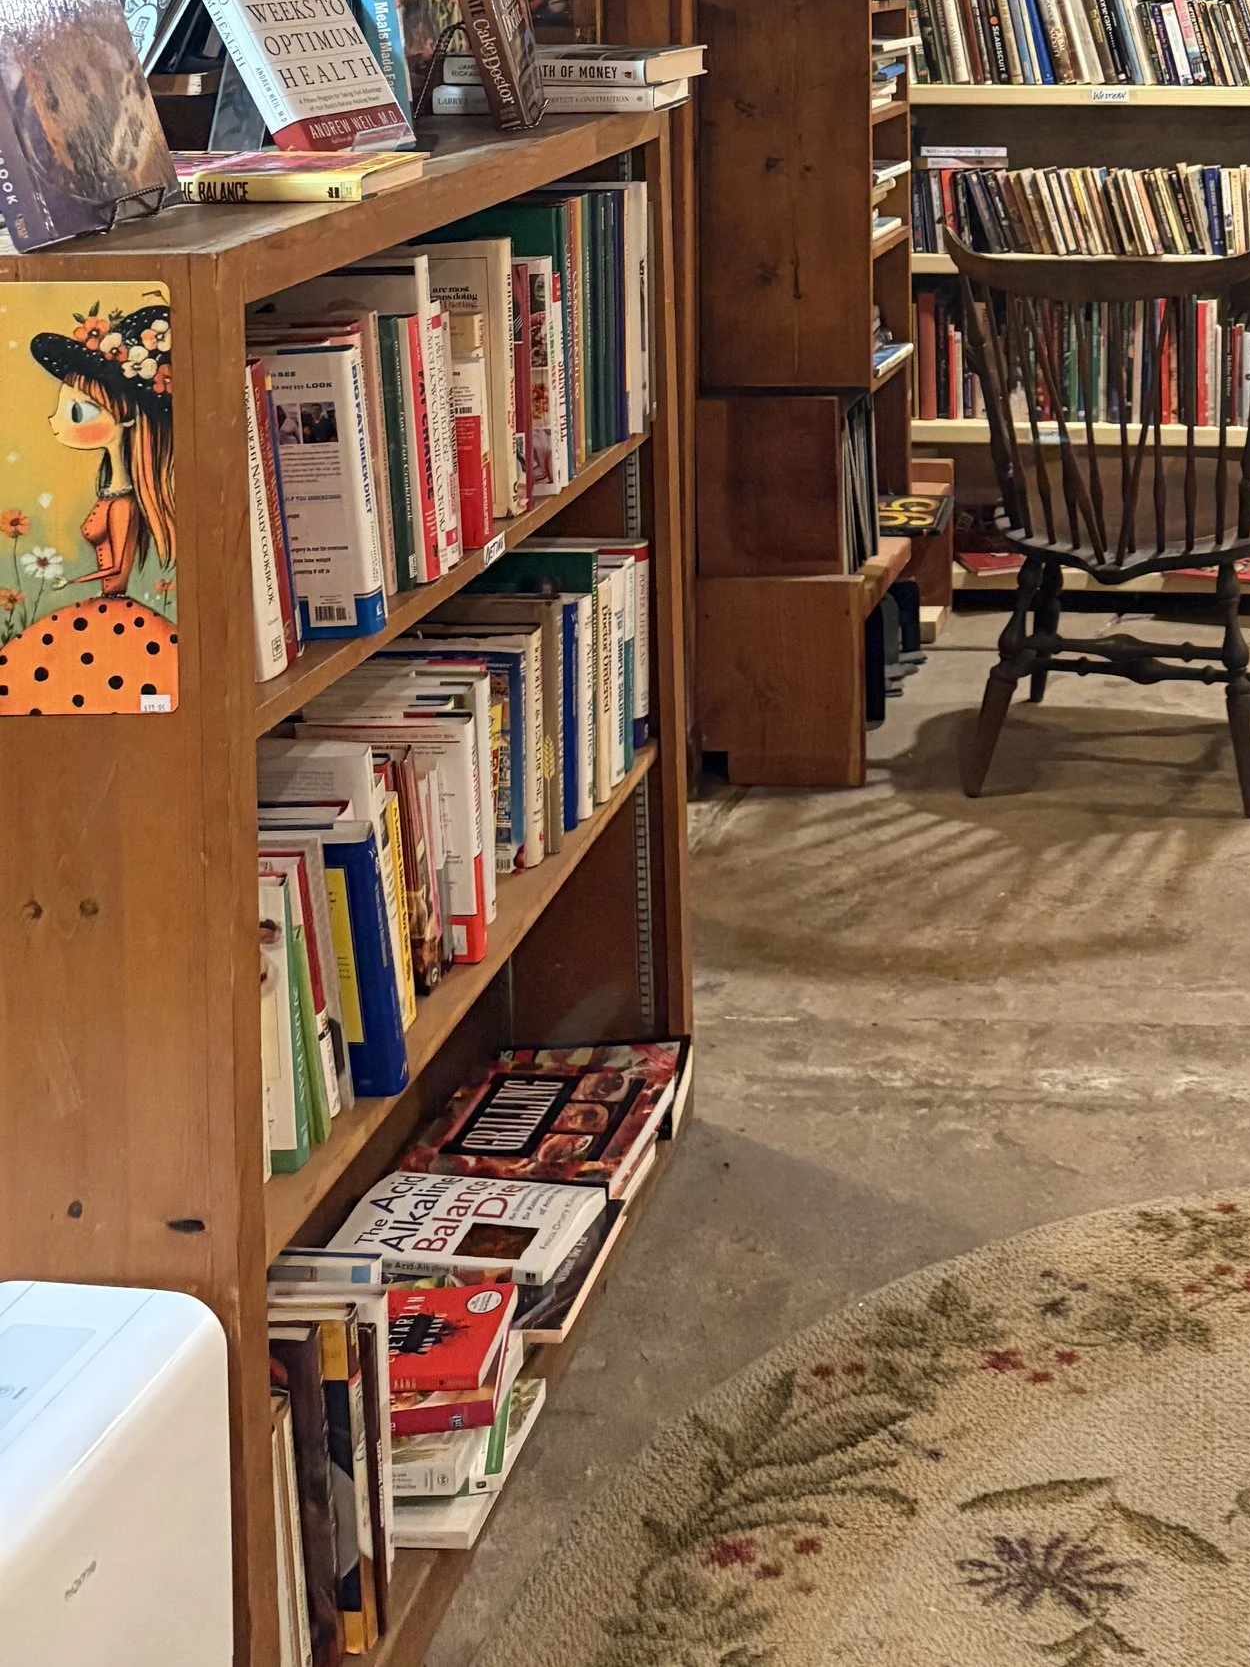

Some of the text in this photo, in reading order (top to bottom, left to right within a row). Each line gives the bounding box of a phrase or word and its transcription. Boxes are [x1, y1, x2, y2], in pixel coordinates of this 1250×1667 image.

[212, 10, 246, 69] HEALTH
[264, 26, 364, 57] OPTIMUM
[1105, 17, 1113, 34] care
[379, 40, 392, 72] Made
[991, 24, 1006, 72] SEABISCUIT
[277, 56, 380, 90] HEALTH
[384, 72, 396, 98] Eas
[560, 65, 574, 79] OF
[578, 64, 618, 79] MONEY
[308, 117, 351, 140] ANDREW
[198, 182, 249, 202] BALANCE
[432, 286, 448, 294] are
[452, 292, 478, 302] doing
[558, 360, 566, 412] SKINNY
[350, 364, 373, 515] BIG FAT GREEK DIET
[250, 463, 266, 530] NATURALLY
[260, 528, 276, 606] COOKBOOK
[460, 1079, 565, 1151] GRILLING
[354, 1174, 427, 1246] The Acid
[380, 1176, 464, 1252] Alkaline
[411, 1180, 496, 1253] Balance
